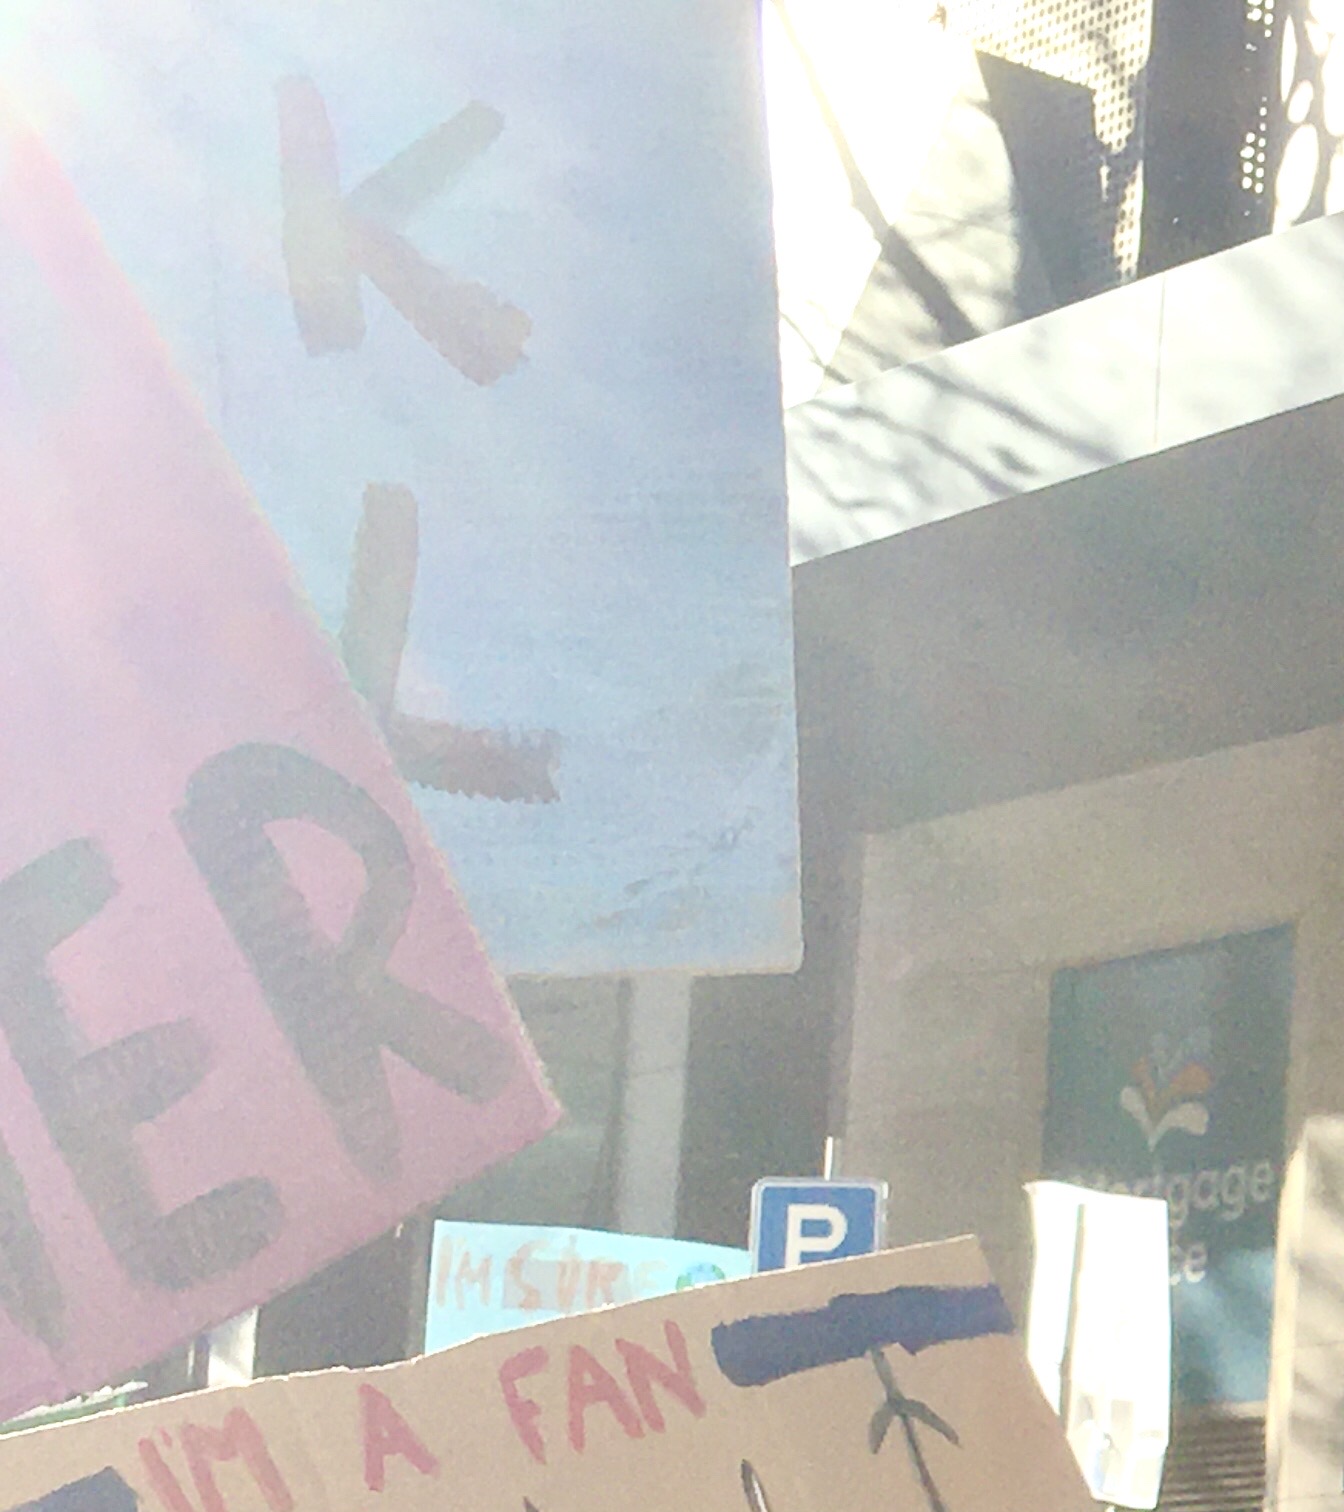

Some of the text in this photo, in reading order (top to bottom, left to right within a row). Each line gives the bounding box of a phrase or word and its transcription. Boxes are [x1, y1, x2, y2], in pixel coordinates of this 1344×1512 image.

[0, 740, 513, 1352] ER
[786, 1203, 848, 1267] P
[359, 1383, 440, 1491] A
[498, 1320, 707, 1463] FAN
